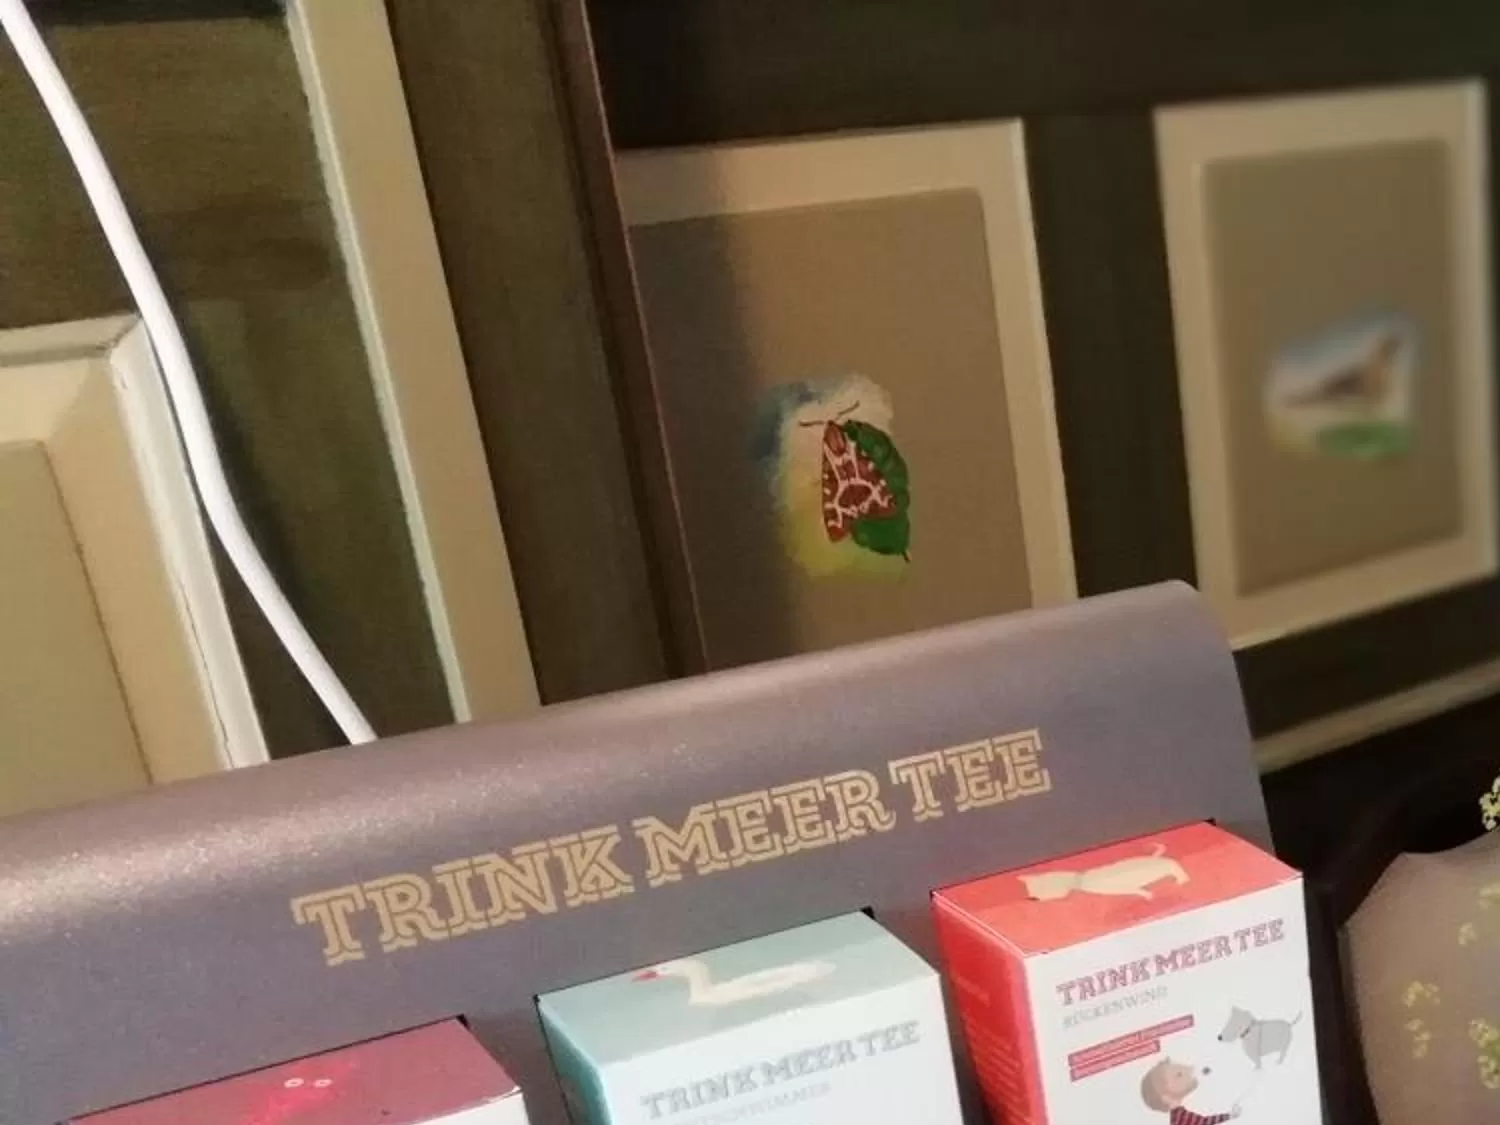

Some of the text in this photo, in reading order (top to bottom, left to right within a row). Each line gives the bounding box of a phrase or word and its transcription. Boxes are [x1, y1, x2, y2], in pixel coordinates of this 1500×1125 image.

[291, 729, 1052, 966] TRINK MEER TEE
[1056, 919, 1285, 1006] TRINK MEER TEE
[640, 1020, 920, 1120] TRINK MEER TEE
